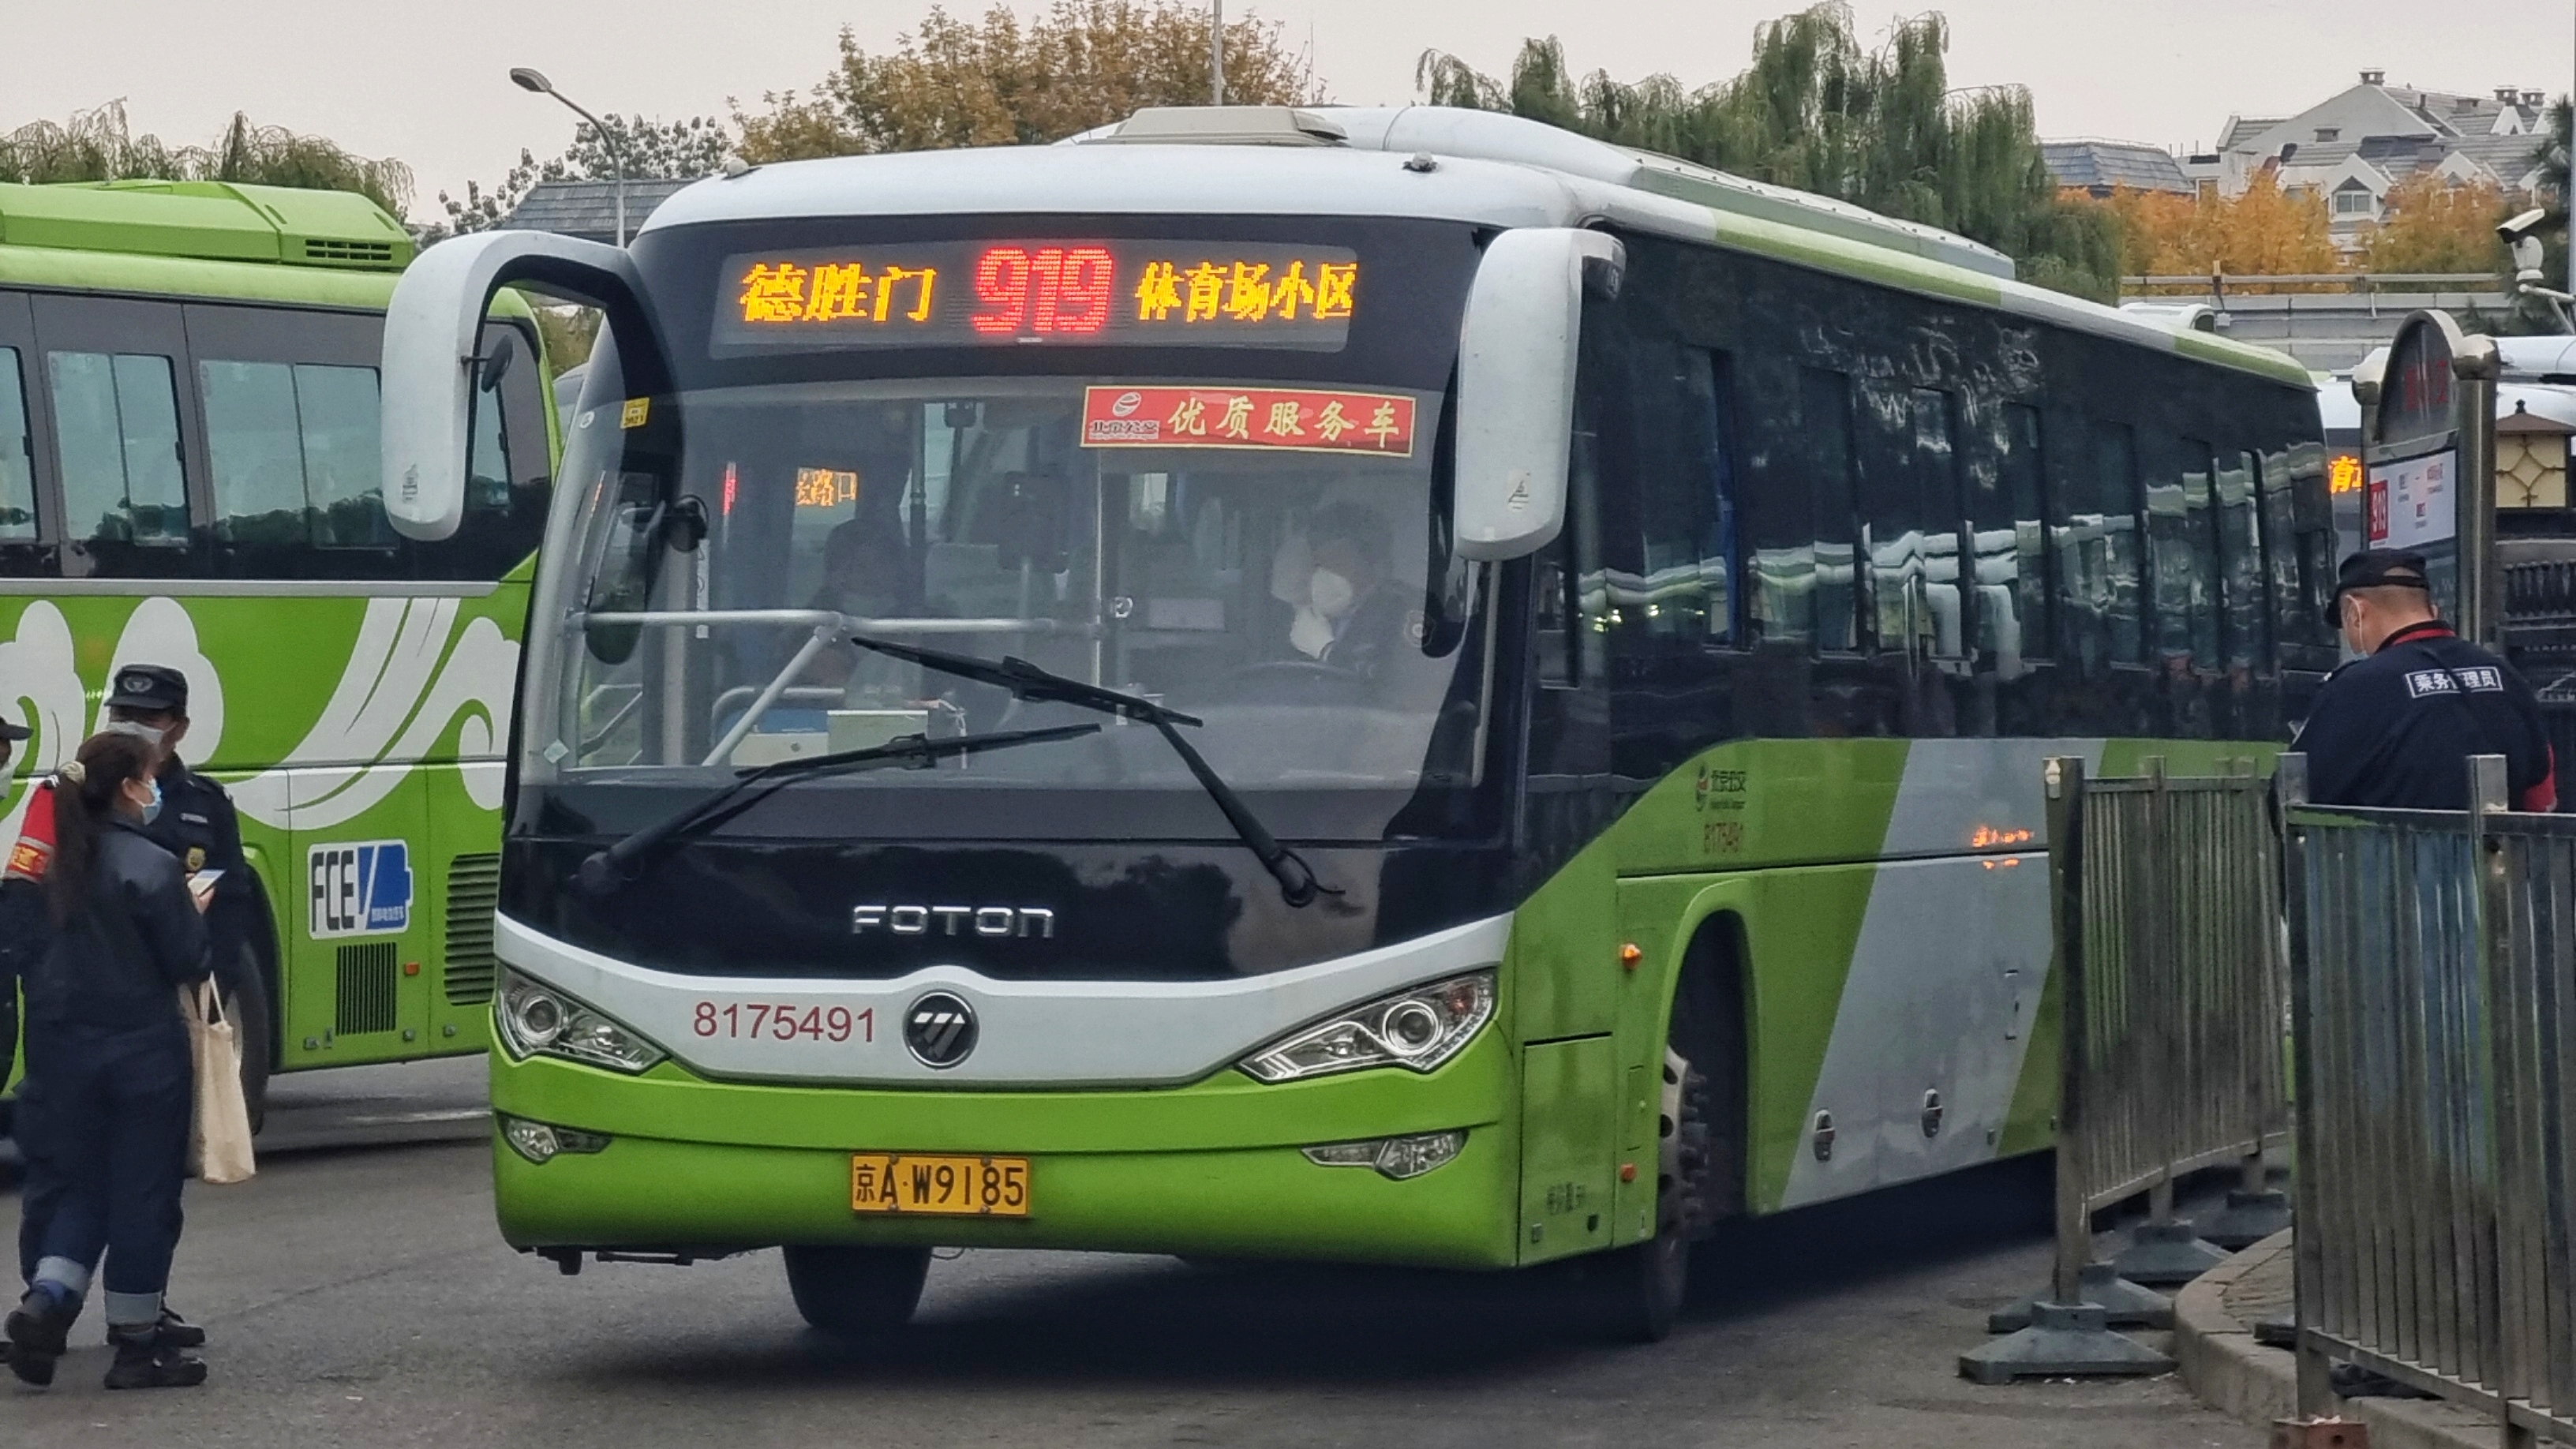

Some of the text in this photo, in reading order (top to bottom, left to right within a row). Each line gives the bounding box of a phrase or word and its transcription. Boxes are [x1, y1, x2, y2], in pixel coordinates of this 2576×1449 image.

[739, 263, 937, 322] 德胜门
[972, 247, 1114, 333] 919
[1135, 260, 1357, 322] 体育场小区
[1167, 395, 1399, 448] 优质服务车
[852, 905, 1054, 938] FOTON
[693, 1001, 874, 1043] 8175491
